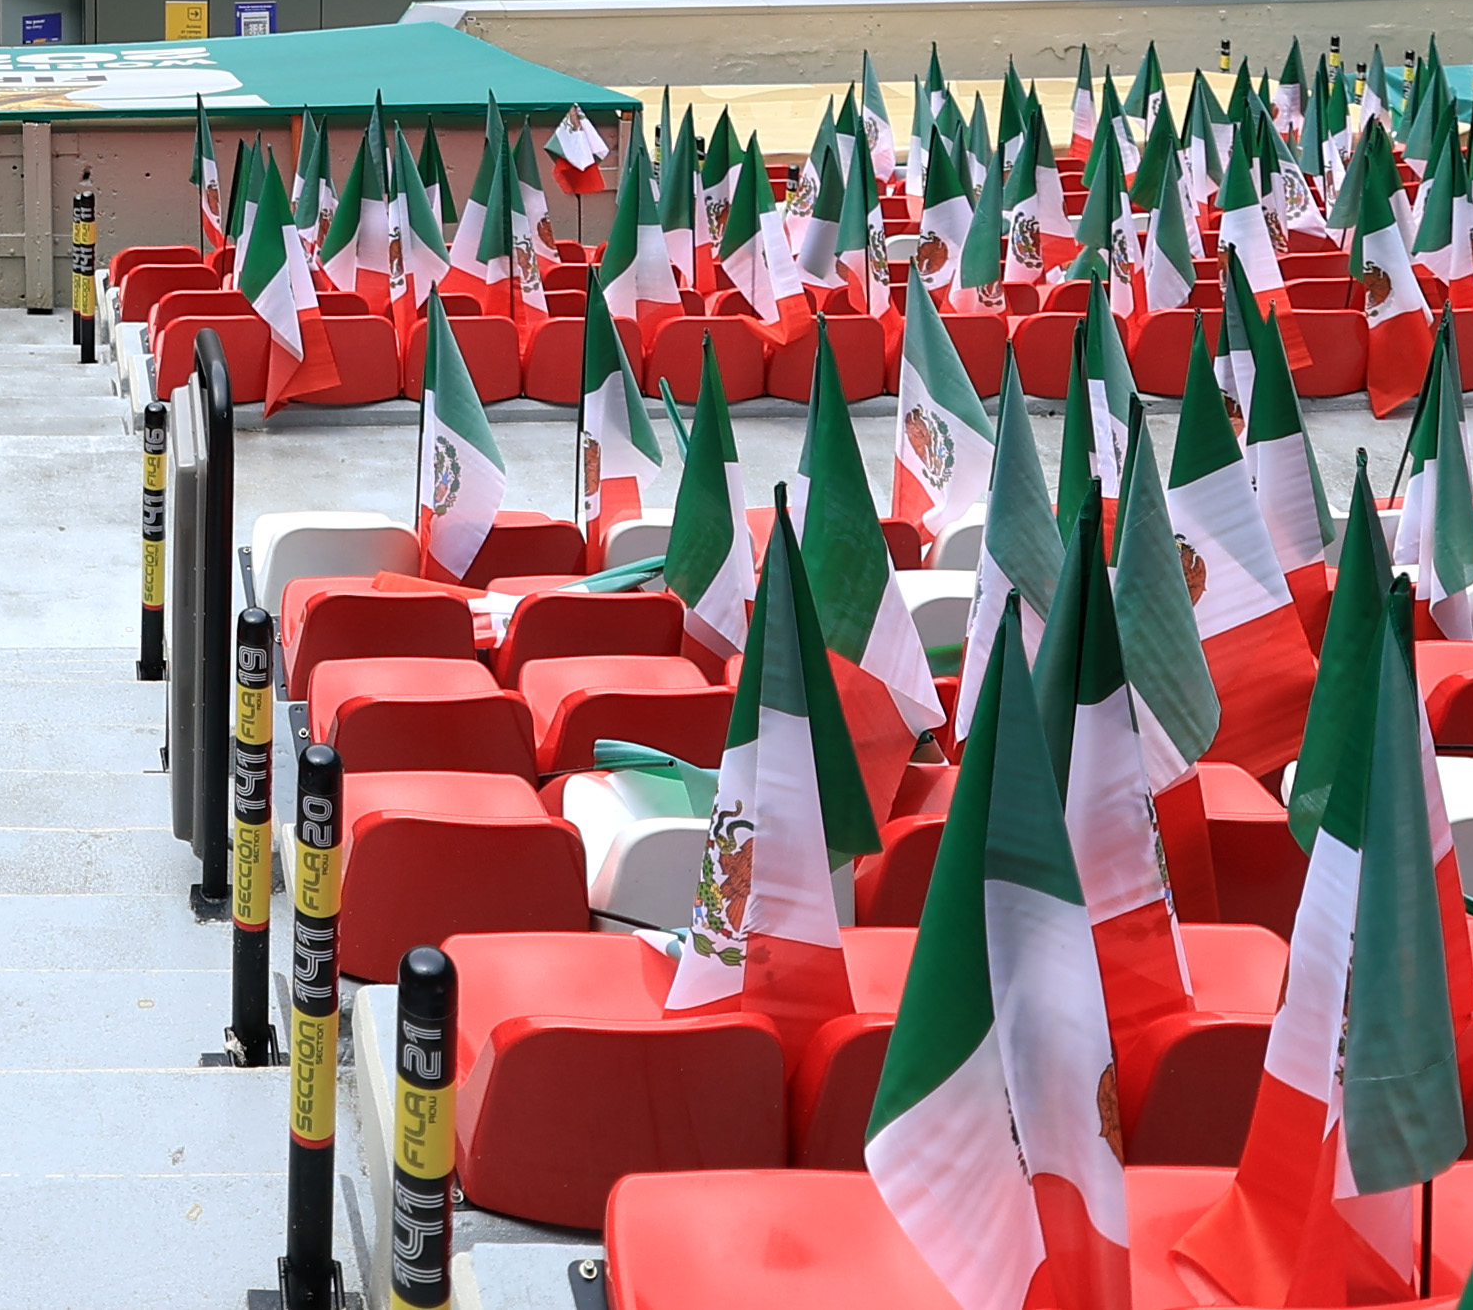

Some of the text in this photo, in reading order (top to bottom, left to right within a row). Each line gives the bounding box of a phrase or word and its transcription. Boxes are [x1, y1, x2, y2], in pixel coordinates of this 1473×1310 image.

[81, 207, 93, 273] 141 11
[143, 427, 165, 602] SECCIÓN 141 FILA 16
[235, 645, 267, 919] SECCIÓN 141 FILA 19
[321, 853, 329, 876] ROW
[293, 795, 334, 1133] SECCIÓN 141 FILA 20
[316, 1023, 324, 1065] SECTION
[393, 1018, 445, 1289] 141 FILA 21
[428, 1094, 438, 1125] ROW
